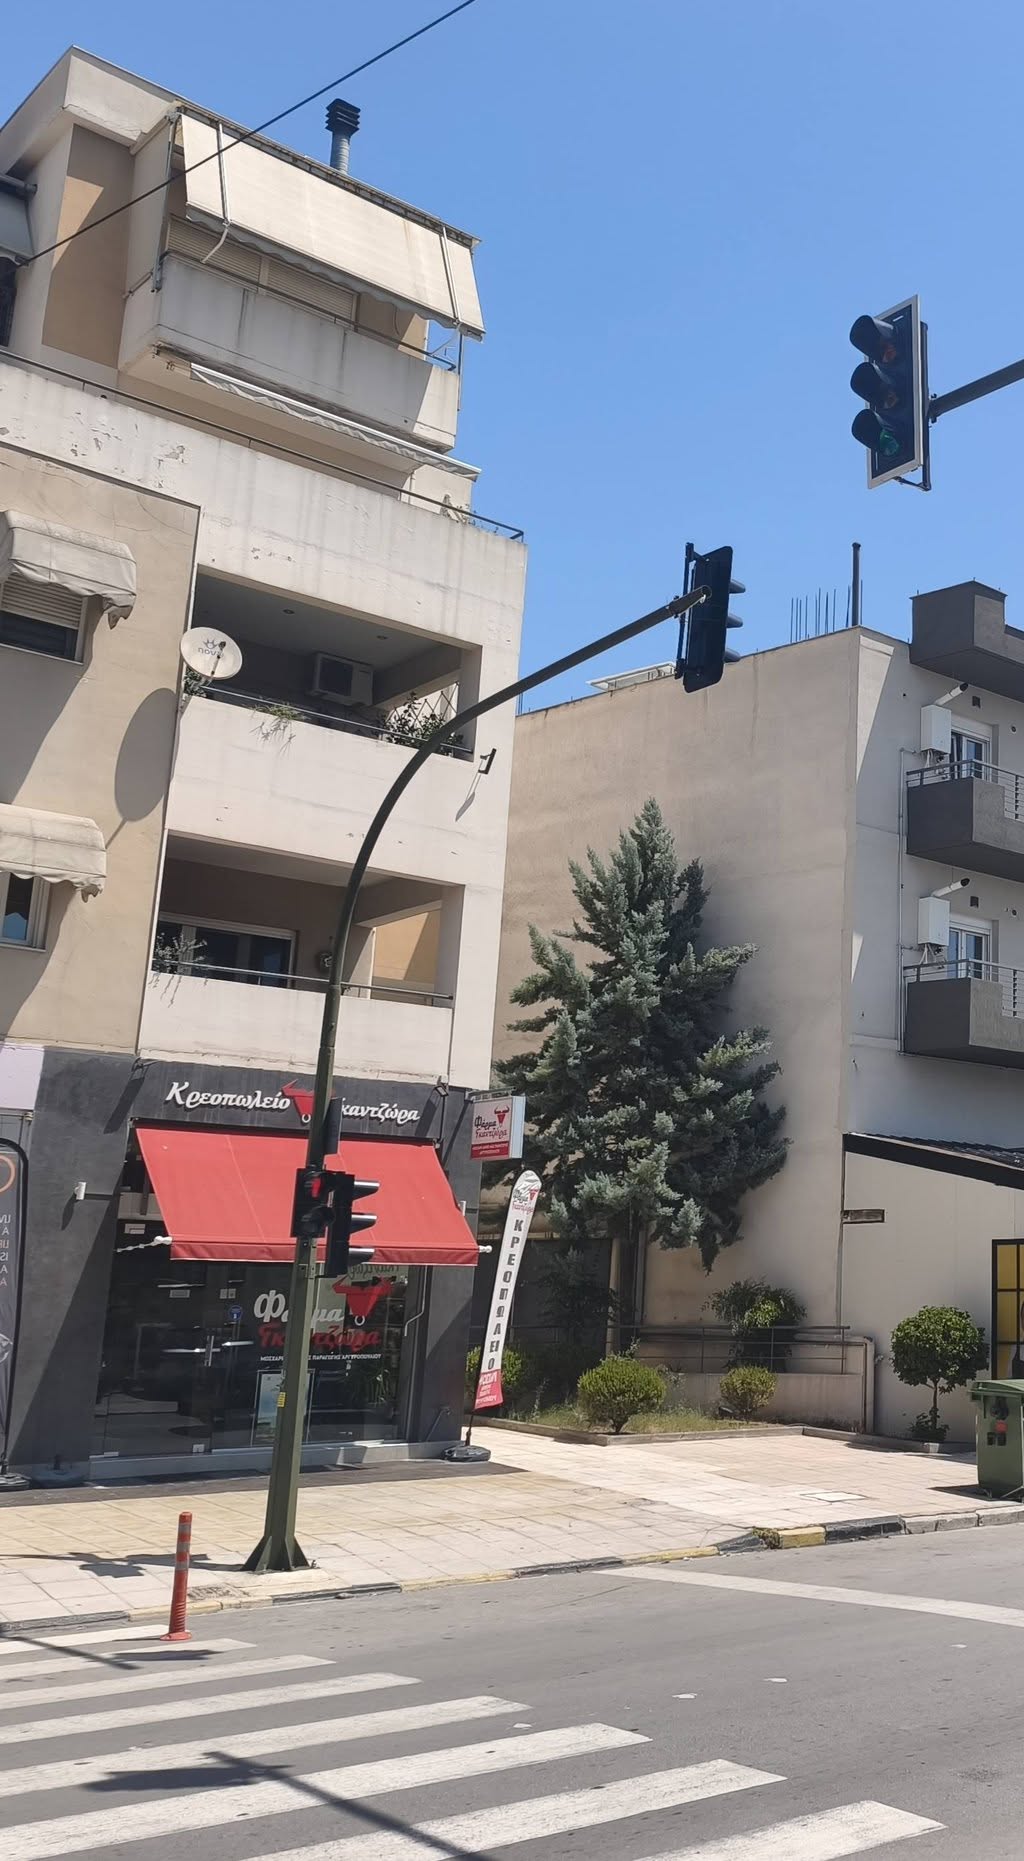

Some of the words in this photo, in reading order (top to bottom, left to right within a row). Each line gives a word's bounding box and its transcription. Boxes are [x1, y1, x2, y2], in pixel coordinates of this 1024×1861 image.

[166, 1081, 291, 1110] Κρεοπωλείο
[341, 1097, 421, 1125] καντζώρα
[254, 1290, 345, 1328] Φμα
[487, 1218, 524, 1370] ΚΡΕΟΠΩΛΕΙΟ
